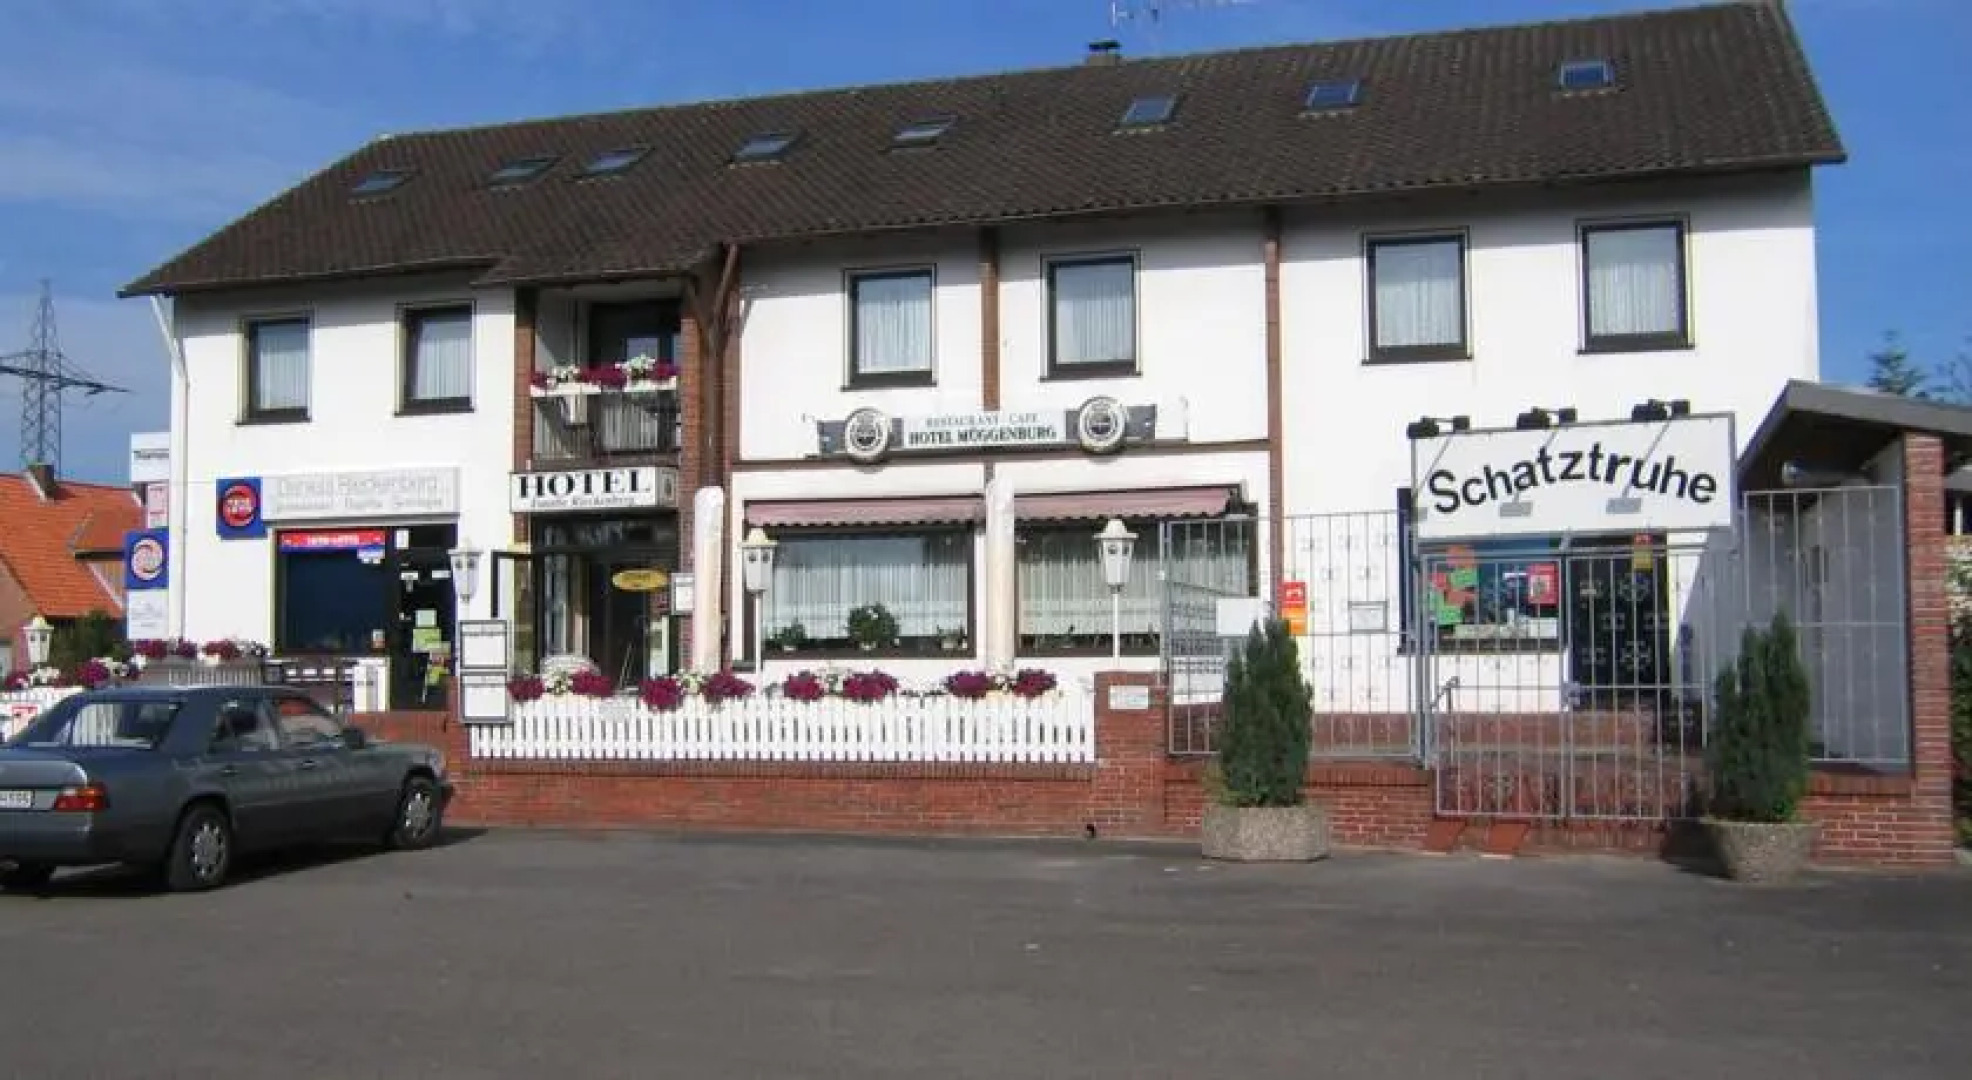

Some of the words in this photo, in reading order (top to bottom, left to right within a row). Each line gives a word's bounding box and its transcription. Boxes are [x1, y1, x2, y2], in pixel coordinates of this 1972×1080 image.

[925, 412, 998, 428] RESTAURANT
[908, 430, 952, 445] HOTEL
[518, 469, 652, 499] HOTEL
[1428, 441, 1718, 514] Schatztruhe
